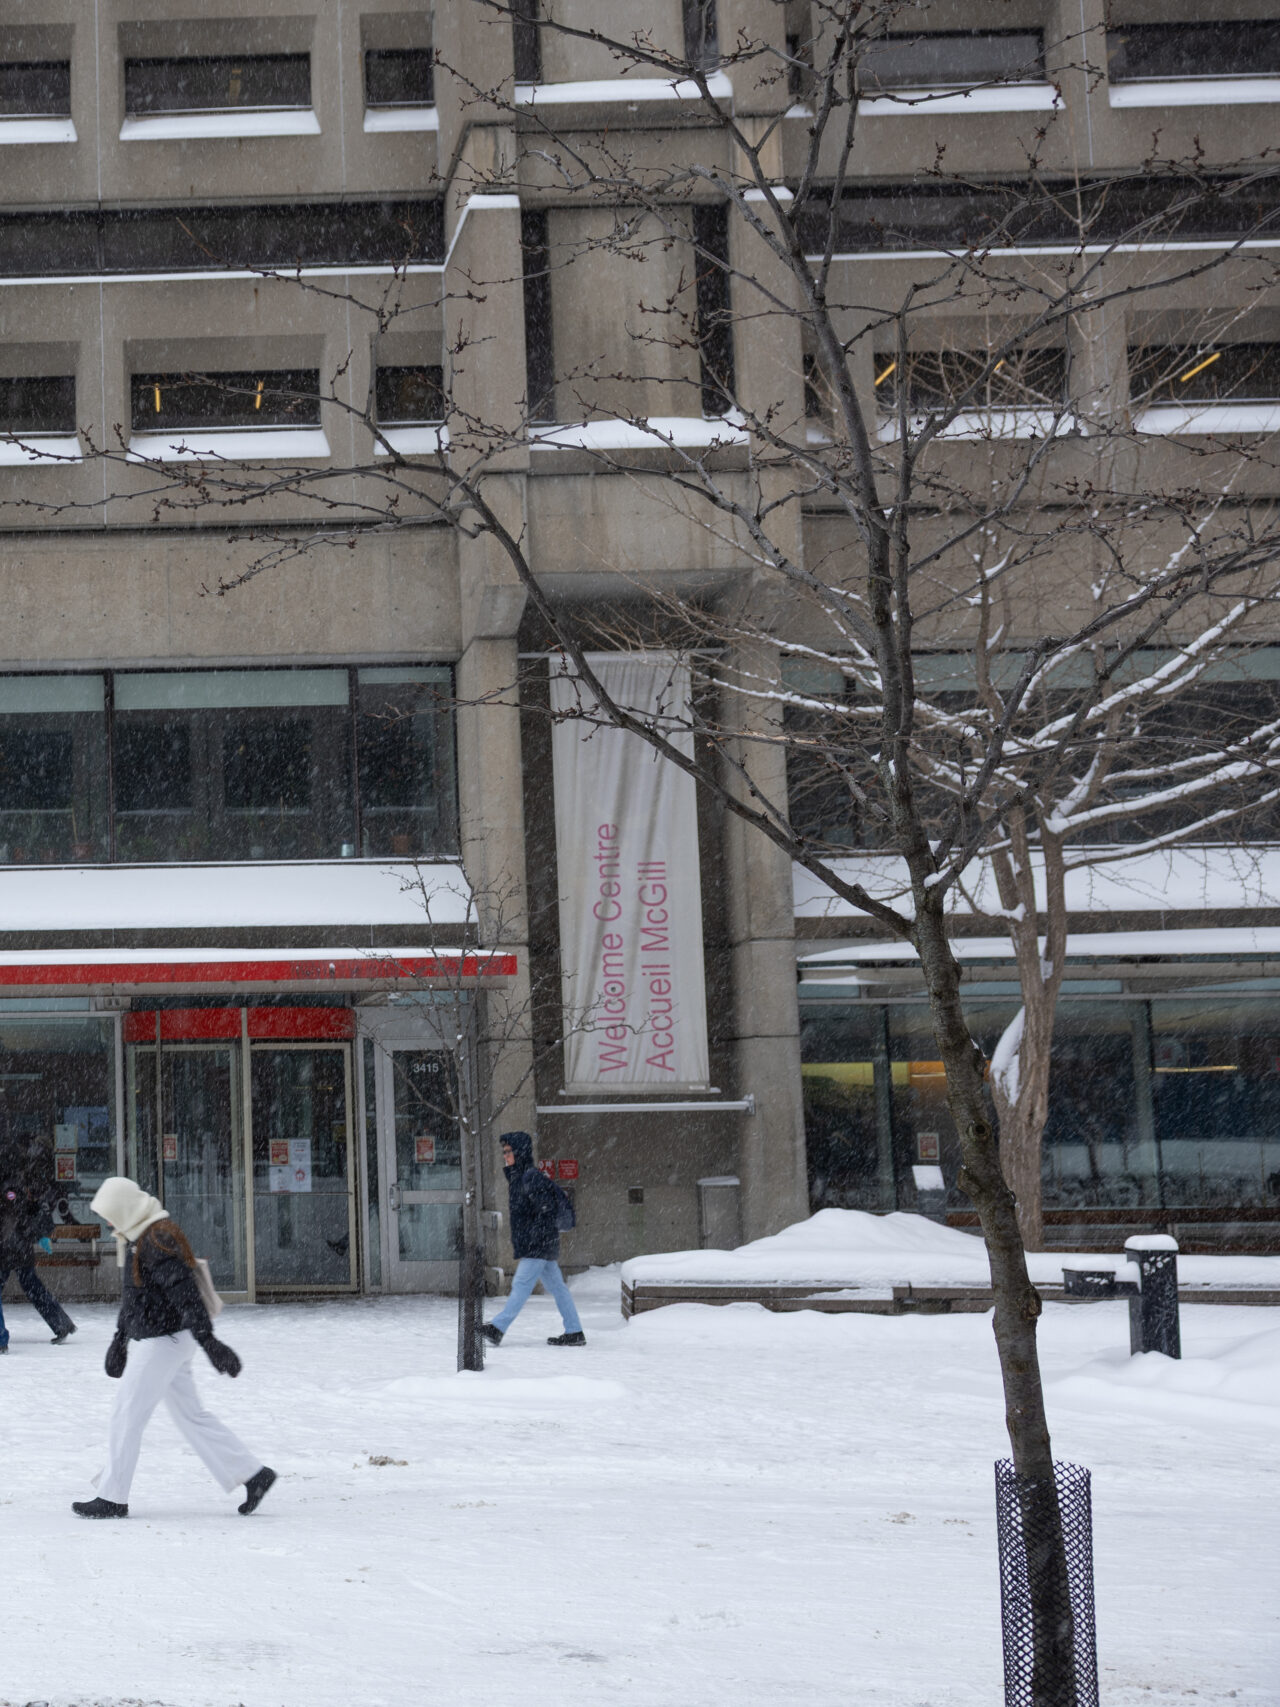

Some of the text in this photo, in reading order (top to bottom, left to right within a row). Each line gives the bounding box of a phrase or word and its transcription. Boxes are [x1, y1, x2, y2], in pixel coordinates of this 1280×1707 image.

[592, 823, 628, 1073] Welcome Centre
[637, 861, 675, 1073] Accueil McGill
[413, 1063, 439, 1073] 3415
